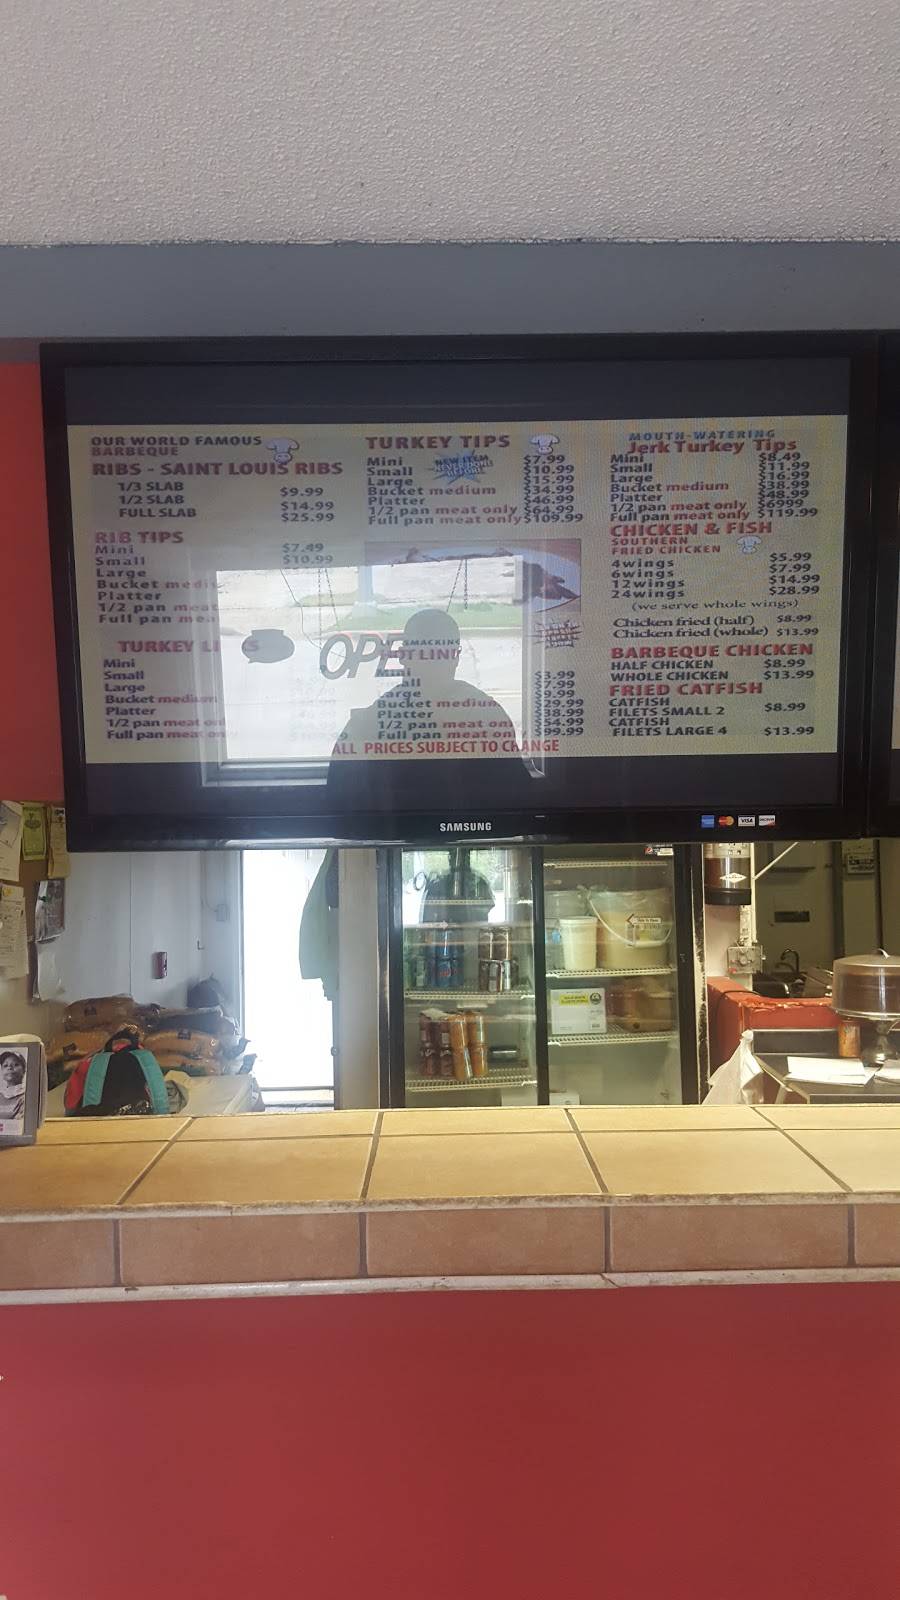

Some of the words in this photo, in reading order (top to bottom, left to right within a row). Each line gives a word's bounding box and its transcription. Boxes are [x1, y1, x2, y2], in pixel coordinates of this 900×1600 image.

[91, 436, 125, 446] OUR
[131, 436, 190, 446] WORLD
[195, 436, 262, 446] FAMOUS
[628, 430, 775, 441] MOUTH-WATERING
[365, 436, 451, 449] TURKEY
[460, 435, 510, 448] TIPS
[628, 441, 669, 454] Jerk
[674, 440, 744, 455] Turkey
[753, 439, 798, 452] Tips
[91, 446, 178, 457] BARBEQUE
[367, 457, 403, 466] Mini
[524, 454, 565, 464] $7.99
[610, 454, 644, 463] Mini
[759, 453, 801, 462] $8.49
[92, 463, 141, 476] RIBS
[160, 463, 222, 476] SAINT
[228, 463, 288, 475] LOUIS
[295, 462, 343, 475] RIBS
[366, 467, 413, 476] Small
[524, 464, 574, 474] $10.99
[610, 464, 652, 472] Small
[759, 462, 810, 472] $11.99
[368, 477, 413, 487] Large
[524, 475, 574, 484] $15.99
[610, 474, 652, 484] Large
[759, 472, 810, 480] $16.99
[118, 482, 141, 492] 1/3
[147, 482, 184, 492] SLAB
[280, 487, 323, 497] $9.99
[368, 486, 424, 496] Bucket
[429, 486, 496, 495] medium
[524, 485, 574, 494] $34.99
[610, 483, 662, 492] Bucket
[666, 482, 729, 491] medium
[119, 495, 142, 504] 1/2
[147, 495, 184, 504] SLAB
[368, 496, 425, 506] Platter
[524, 494, 574, 504] $46.99
[610, 493, 662, 502] Platter
[281, 501, 334, 511] $14.99
[369, 506, 395, 515] 1/2
[400, 508, 430, 517] pan
[436, 506, 480, 514] meat
[483, 504, 517, 516] only
[524, 504, 574, 514] $64.99
[611, 503, 634, 512] 1/2
[638, 504, 666, 514] pan
[671, 502, 710, 511] meat
[714, 501, 747, 512] only
[119, 508, 158, 518] FULL
[159, 508, 196, 518] SLAB
[281, 512, 334, 523] $25.99
[610, 513, 637, 522] Full
[642, 514, 669, 524] pan
[674, 512, 713, 520] meat
[718, 510, 750, 522] only
[758, 508, 818, 518] $119.99
[368, 516, 398, 525] Full
[404, 517, 434, 527] pan
[440, 516, 480, 524] meat
[487, 514, 522, 526] only
[524, 514, 583, 524] $109.99
[610, 524, 698, 536] CHICKEN
[704, 523, 720, 535] &
[726, 522, 772, 534] FISH
[95, 532, 132, 544] RIB
[138, 532, 184, 544] TIPS
[612, 538, 688, 546] SOUTHERN
[95, 545, 134, 554] Mini
[282, 543, 324, 552] $7.49
[612, 547, 654, 556] FRIED
[659, 546, 721, 554] CHICKEN
[95, 556, 145, 566] Small
[283, 554, 333, 564] $10.99
[769, 552, 812, 562] $5.99
[96, 568, 146, 579] Large
[769, 564, 811, 573] $7.99
[97, 580, 158, 589] Bucket
[769, 574, 820, 584] $14.99
[98, 591, 162, 600] Platter
[769, 586, 820, 596] $28.99
[632, 602, 657, 612] (we
[704, 600, 746, 608] whole
[752, 600, 799, 610] wings)
[99, 614, 132, 624] Full
[139, 616, 171, 626] pan
[613, 618, 673, 627] Chicken
[676, 616, 711, 626] fried
[714, 615, 754, 628] (half)
[776, 614, 812, 623] $8.99
[613, 628, 673, 638] Chicken
[676, 628, 711, 637] fried
[714, 627, 769, 638] (whole)
[776, 627, 819, 637] $13.99
[118, 640, 194, 652] TURKEY
[611, 645, 720, 659] BARBEQUE
[725, 643, 814, 656] CHICKEN
[320, 633, 405, 680] OPE
[103, 658, 135, 668] Mini
[611, 661, 647, 670] HALF
[652, 660, 714, 670] CHICKEN
[764, 659, 806, 668] $8.99
[103, 670, 144, 680] Small
[611, 672, 662, 682] WHOLE
[666, 671, 729, 681] CHICKEN
[764, 670, 814, 680] $13.99
[104, 683, 145, 694] Large
[534, 680, 575, 689] $7.99
[609, 684, 670, 697] FRIED
[677, 682, 763, 696] CATFISH
[105, 694, 154, 704] Bucket
[534, 690, 575, 698] $9.99
[378, 699, 432, 708] Bucket
[534, 699, 584, 708] $29.99
[608, 698, 670, 708] CATFISH
[106, 706, 156, 716] Platter
[378, 710, 434, 719] Platter
[609, 707, 660, 717] FILETS
[662, 706, 712, 716] SMALL
[716, 706, 725, 716] 2
[764, 702, 806, 712] $8.99
[408, 722, 436, 731] pan
[442, 720, 485, 729] meat
[608, 717, 670, 727] CATFISH
[107, 730, 133, 739] Full
[136, 732, 164, 741] pan
[378, 730, 406, 740] Full
[412, 732, 441, 742] pan
[447, 730, 491, 739] meat
[612, 728, 662, 737] FILETS
[666, 726, 714, 736] LARGE
[718, 726, 726, 735] 4
[764, 726, 814, 736] $13.99
[332, 742, 358, 754] ALL
[364, 742, 414, 754] PRICES
[417, 742, 478, 754] SUBJECT
[482, 741, 498, 753] TO
[502, 740, 560, 753] CHANGE
[439, 822, 492, 832] SAMSUNG
